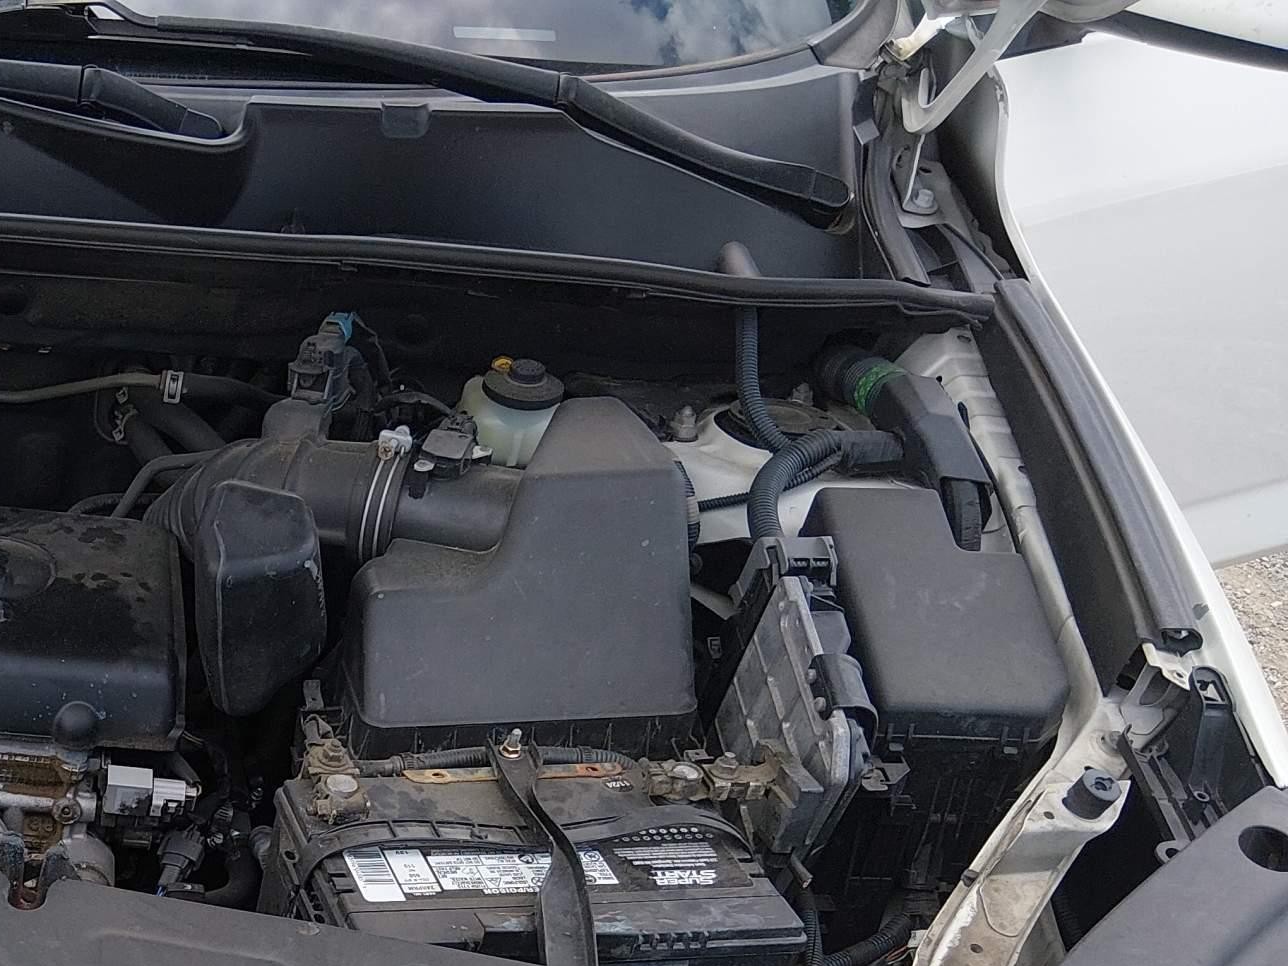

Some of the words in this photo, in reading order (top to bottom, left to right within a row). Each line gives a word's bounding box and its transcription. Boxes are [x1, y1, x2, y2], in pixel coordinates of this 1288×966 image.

[652, 869, 716, 879] START
[655, 877, 715, 885] SUPER
[483, 886, 540, 895] ER/POISON
